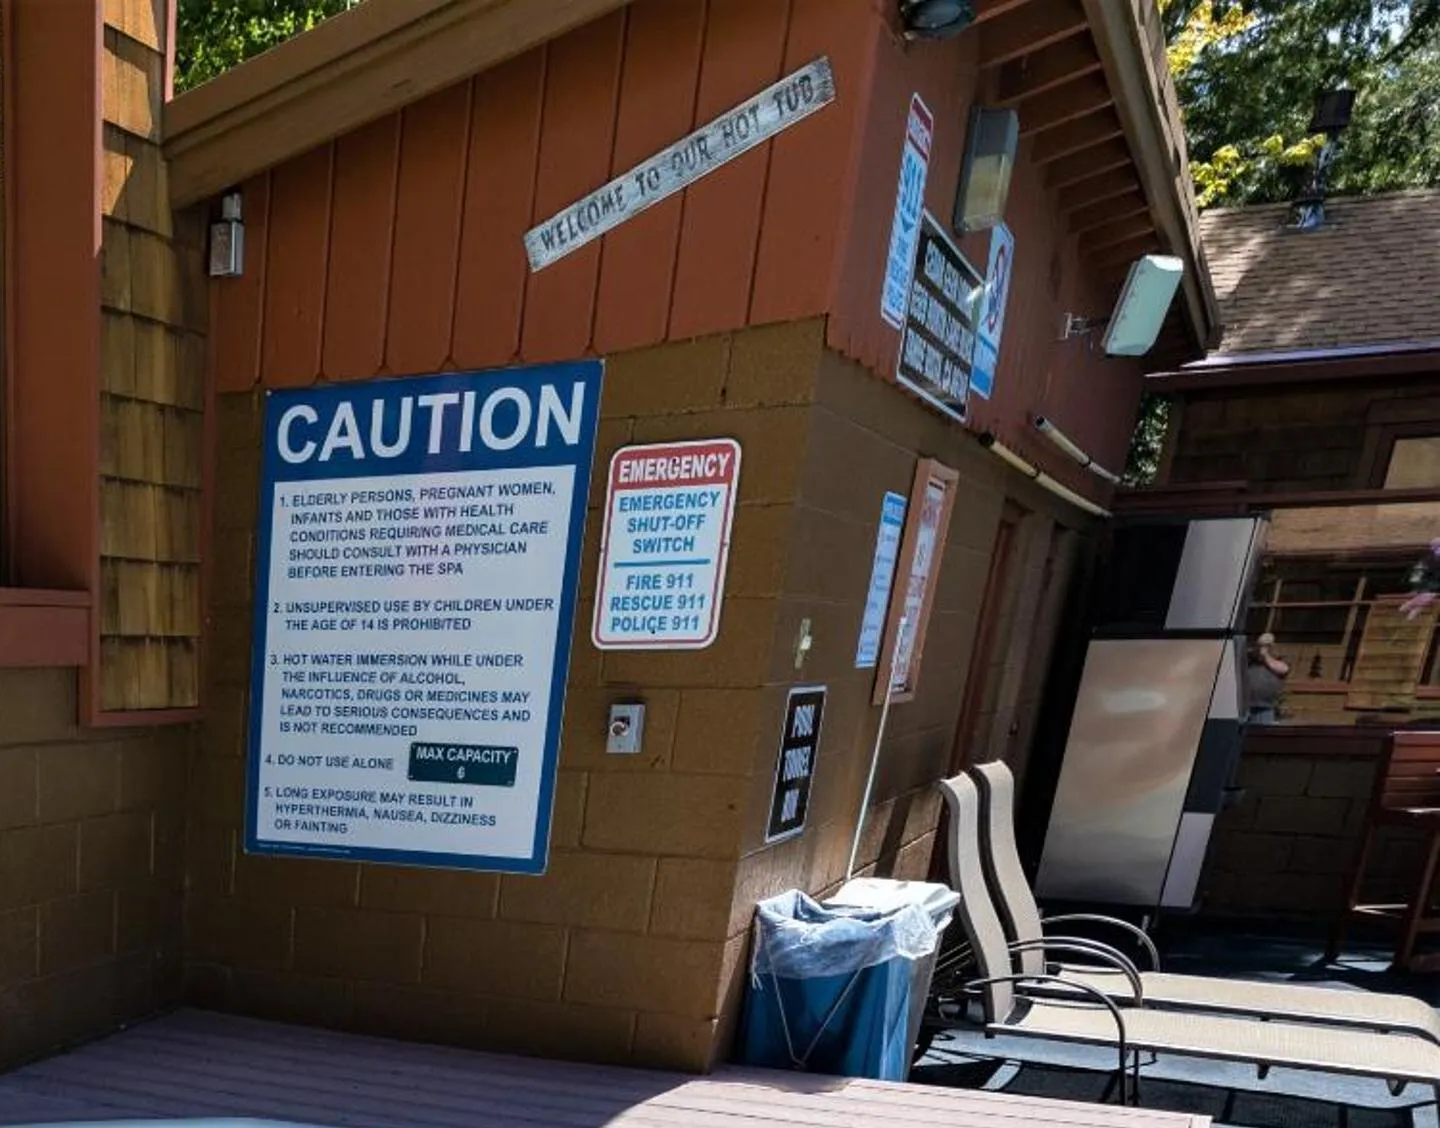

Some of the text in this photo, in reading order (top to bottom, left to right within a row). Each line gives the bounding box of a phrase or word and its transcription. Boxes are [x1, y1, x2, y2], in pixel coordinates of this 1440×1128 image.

[541, 184, 624, 251] WELCOME
[634, 169, 660, 198] TO
[671, 136, 712, 177] OUR
[720, 103, 760, 149] HOT
[277, 381, 585, 463] CAUTION
[619, 452, 730, 483] EMERGENCY
[293, 491, 346, 507] ELDERLY
[419, 484, 493, 501] PREGNANT
[619, 491, 720, 512] EMERGENCY
[291, 503, 513, 524] INFANTS AND THOSE WITH HEALTH
[290, 521, 547, 542] CONDITIONS REQUIRING MEDICAL CARE
[627, 514, 706, 533] SHUT-OFF
[289, 541, 527, 560] SHOULD CONSULT WITH A PHYSICIAN
[633, 536, 694, 554] SWITCH
[287, 561, 463, 578] BEFORE ENTERING THE SPA
[626, 574, 694, 590] FIRE 911
[286, 600, 380, 613] UNSUPERVISED
[383, 600, 409, 612] USE
[412, 599, 430, 612] BY
[433, 598, 501, 612] CHILDREN
[505, 598, 553, 611] UNDER
[610, 594, 705, 612] RESCUE 911
[285, 617, 471, 630] THE AGE OF 14 IS PROHIBITED
[611, 615, 699, 632] POLICE 911
[283, 653, 308, 665] HOT
[310, 653, 352, 665] WATER
[356, 653, 427, 666] IMMERSION
[430, 654, 472, 666] WHILE
[475, 654, 523, 667] UNDER
[282, 670, 304, 682] THE
[308, 671, 376, 683] INFLUENCE
[379, 672, 395, 684] OF
[357, 688, 400, 701] DRUGS
[404, 689, 423, 701] OR
[426, 690, 498, 703] MEDICINES
[500, 691, 529, 703] MAY
[280, 704, 530, 722] LEAD TO SERIOUS CONSEQUENCES AND
[279, 721, 417, 736] IS NOT RECOMMENDED
[277, 754, 294, 765] DO
[297, 755, 322, 767] NOT
[325, 756, 348, 768] USE
[352, 757, 392, 770] ALONE
[416, 746, 511, 764] MAX CAPACITY
[276, 786, 308, 799] LONG
[312, 788, 376, 803] EXPOSURE
[379, 791, 405, 804] MAY
[408, 793, 455, 807] RESULT
[460, 796, 472, 808] IN
[274, 818, 347, 833] OR FAINTING
[430, 811, 496, 827] DIZZINESS
